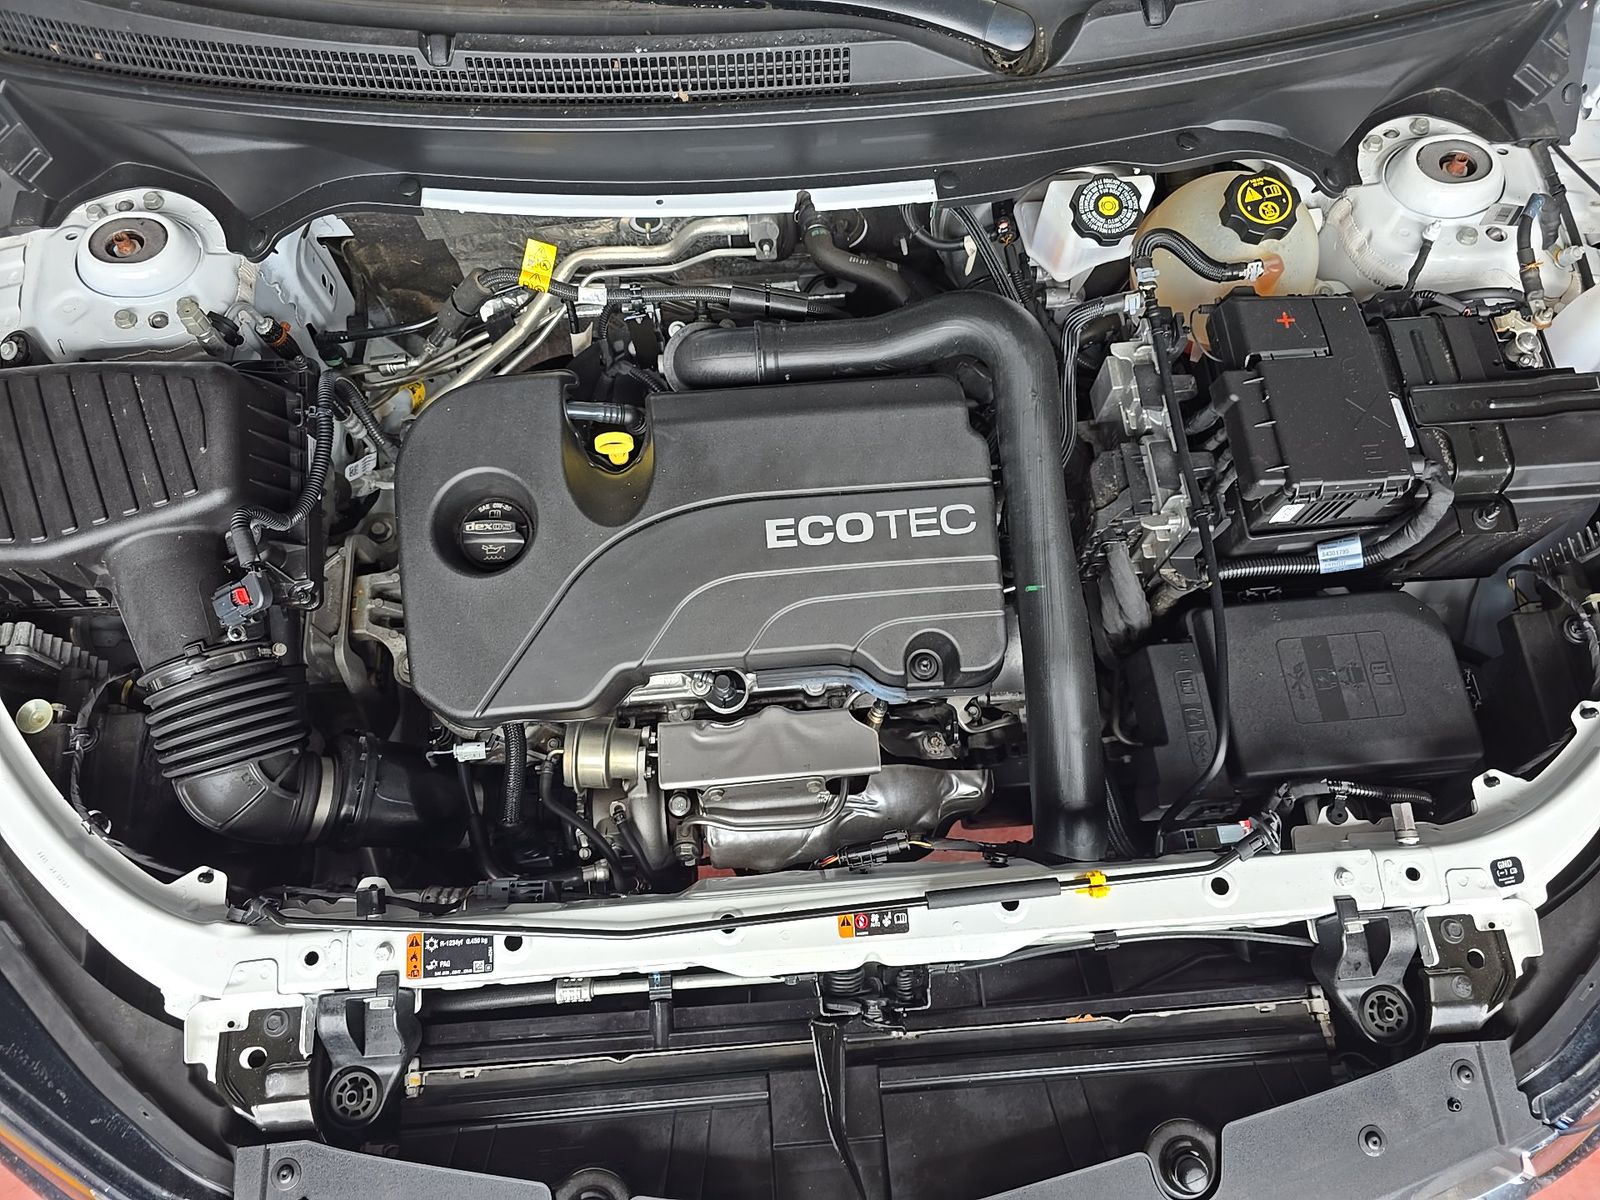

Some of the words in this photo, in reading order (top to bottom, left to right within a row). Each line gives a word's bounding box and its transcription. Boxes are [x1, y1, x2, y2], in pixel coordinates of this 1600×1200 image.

[477, 503, 491, 513] SAE
[465, 522, 512, 531] dexos
[765, 503, 977, 549] ECOTEC
[1497, 859, 1513, 870] GND
